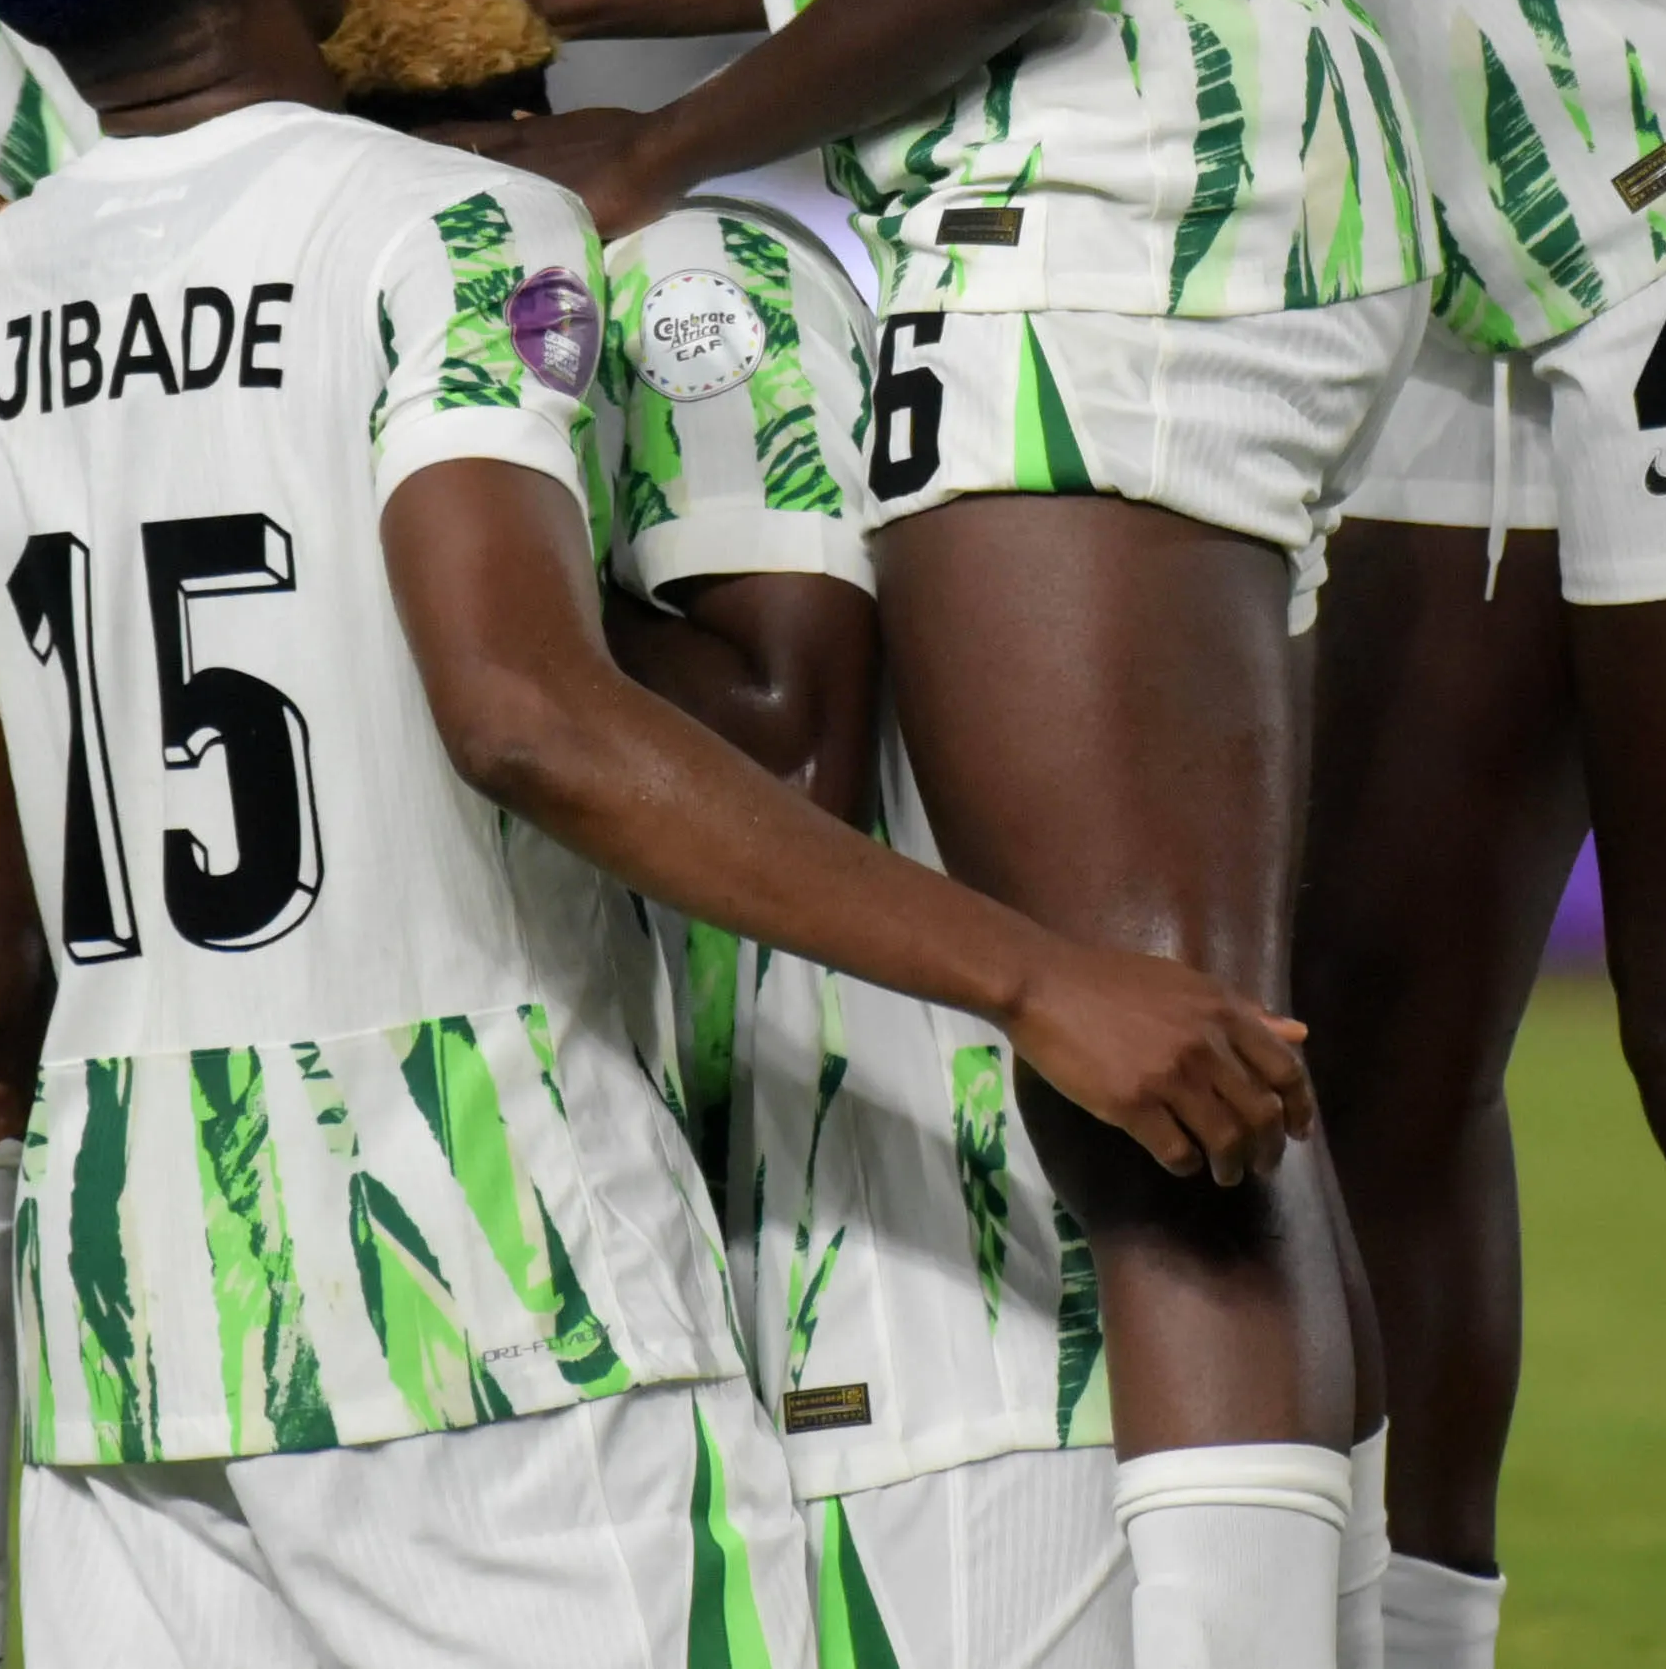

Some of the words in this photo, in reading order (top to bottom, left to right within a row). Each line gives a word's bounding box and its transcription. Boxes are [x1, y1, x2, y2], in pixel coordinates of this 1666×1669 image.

[654, 312, 735, 341] Celebrate
[671, 324, 720, 349] Africa
[676, 339, 723, 362] CAF
[868, 312, 945, 503] 6
[6, 513, 324, 965] 15
